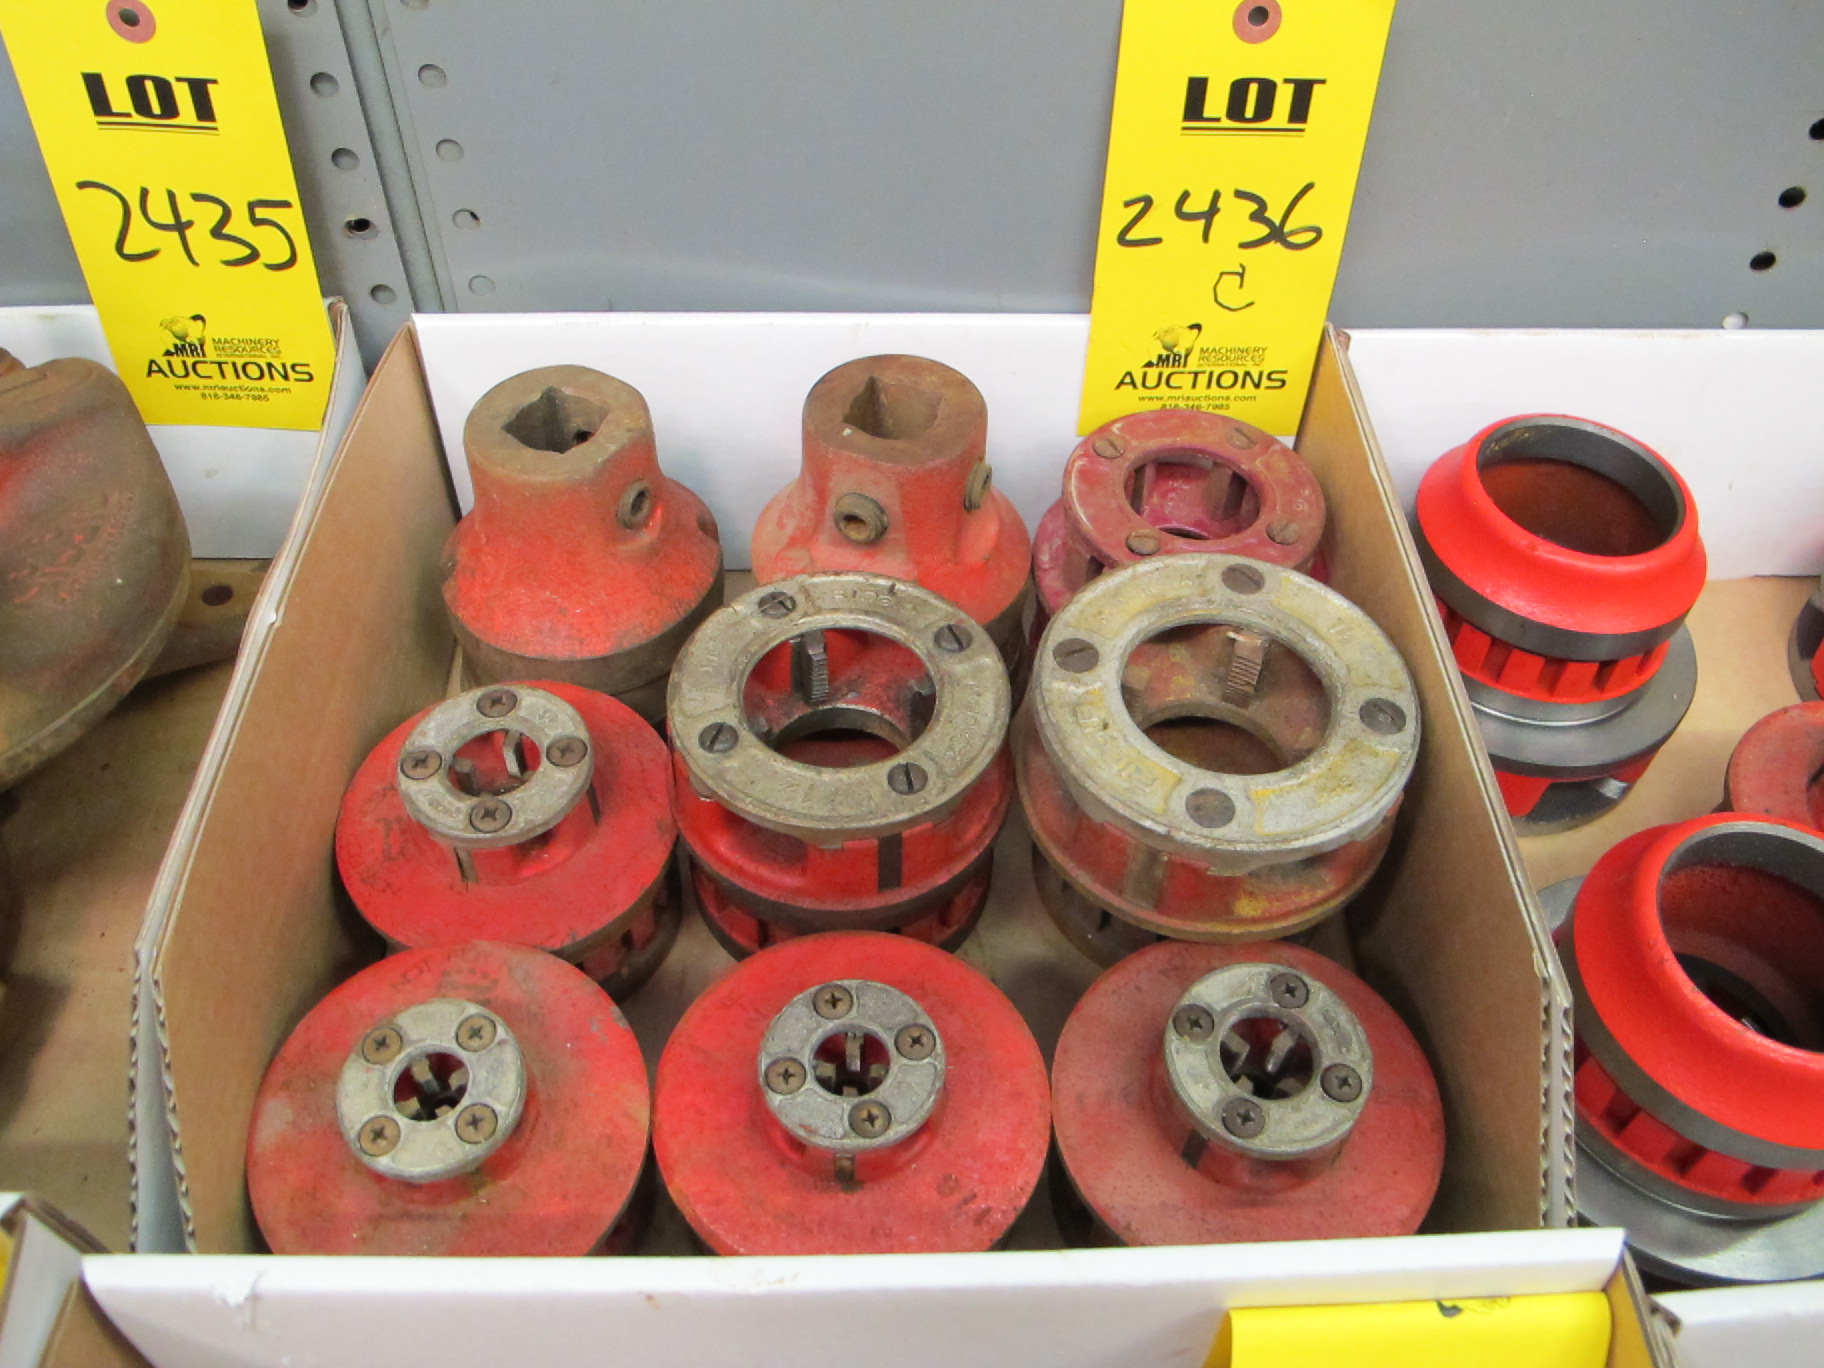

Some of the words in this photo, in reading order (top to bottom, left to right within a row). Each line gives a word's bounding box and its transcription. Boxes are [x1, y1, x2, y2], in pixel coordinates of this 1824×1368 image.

[80, 71, 219, 122] LOT
[1182, 76, 1327, 124] LOT
[76, 180, 298, 271] 2435
[1117, 182, 1323, 251] 2436
[173, 342, 206, 358] MRI
[211, 337, 280, 349] MACHINERY
[1199, 345, 1269, 355] MACHINERY
[1155, 352, 1190, 368] MRI
[1198, 354, 1265, 363] RESOURCES
[146, 358, 314, 382] AUCTIONS
[1114, 369, 1289, 390] AUCTIONS
[1137, 393, 1257, 403] www.mriauctions.com
